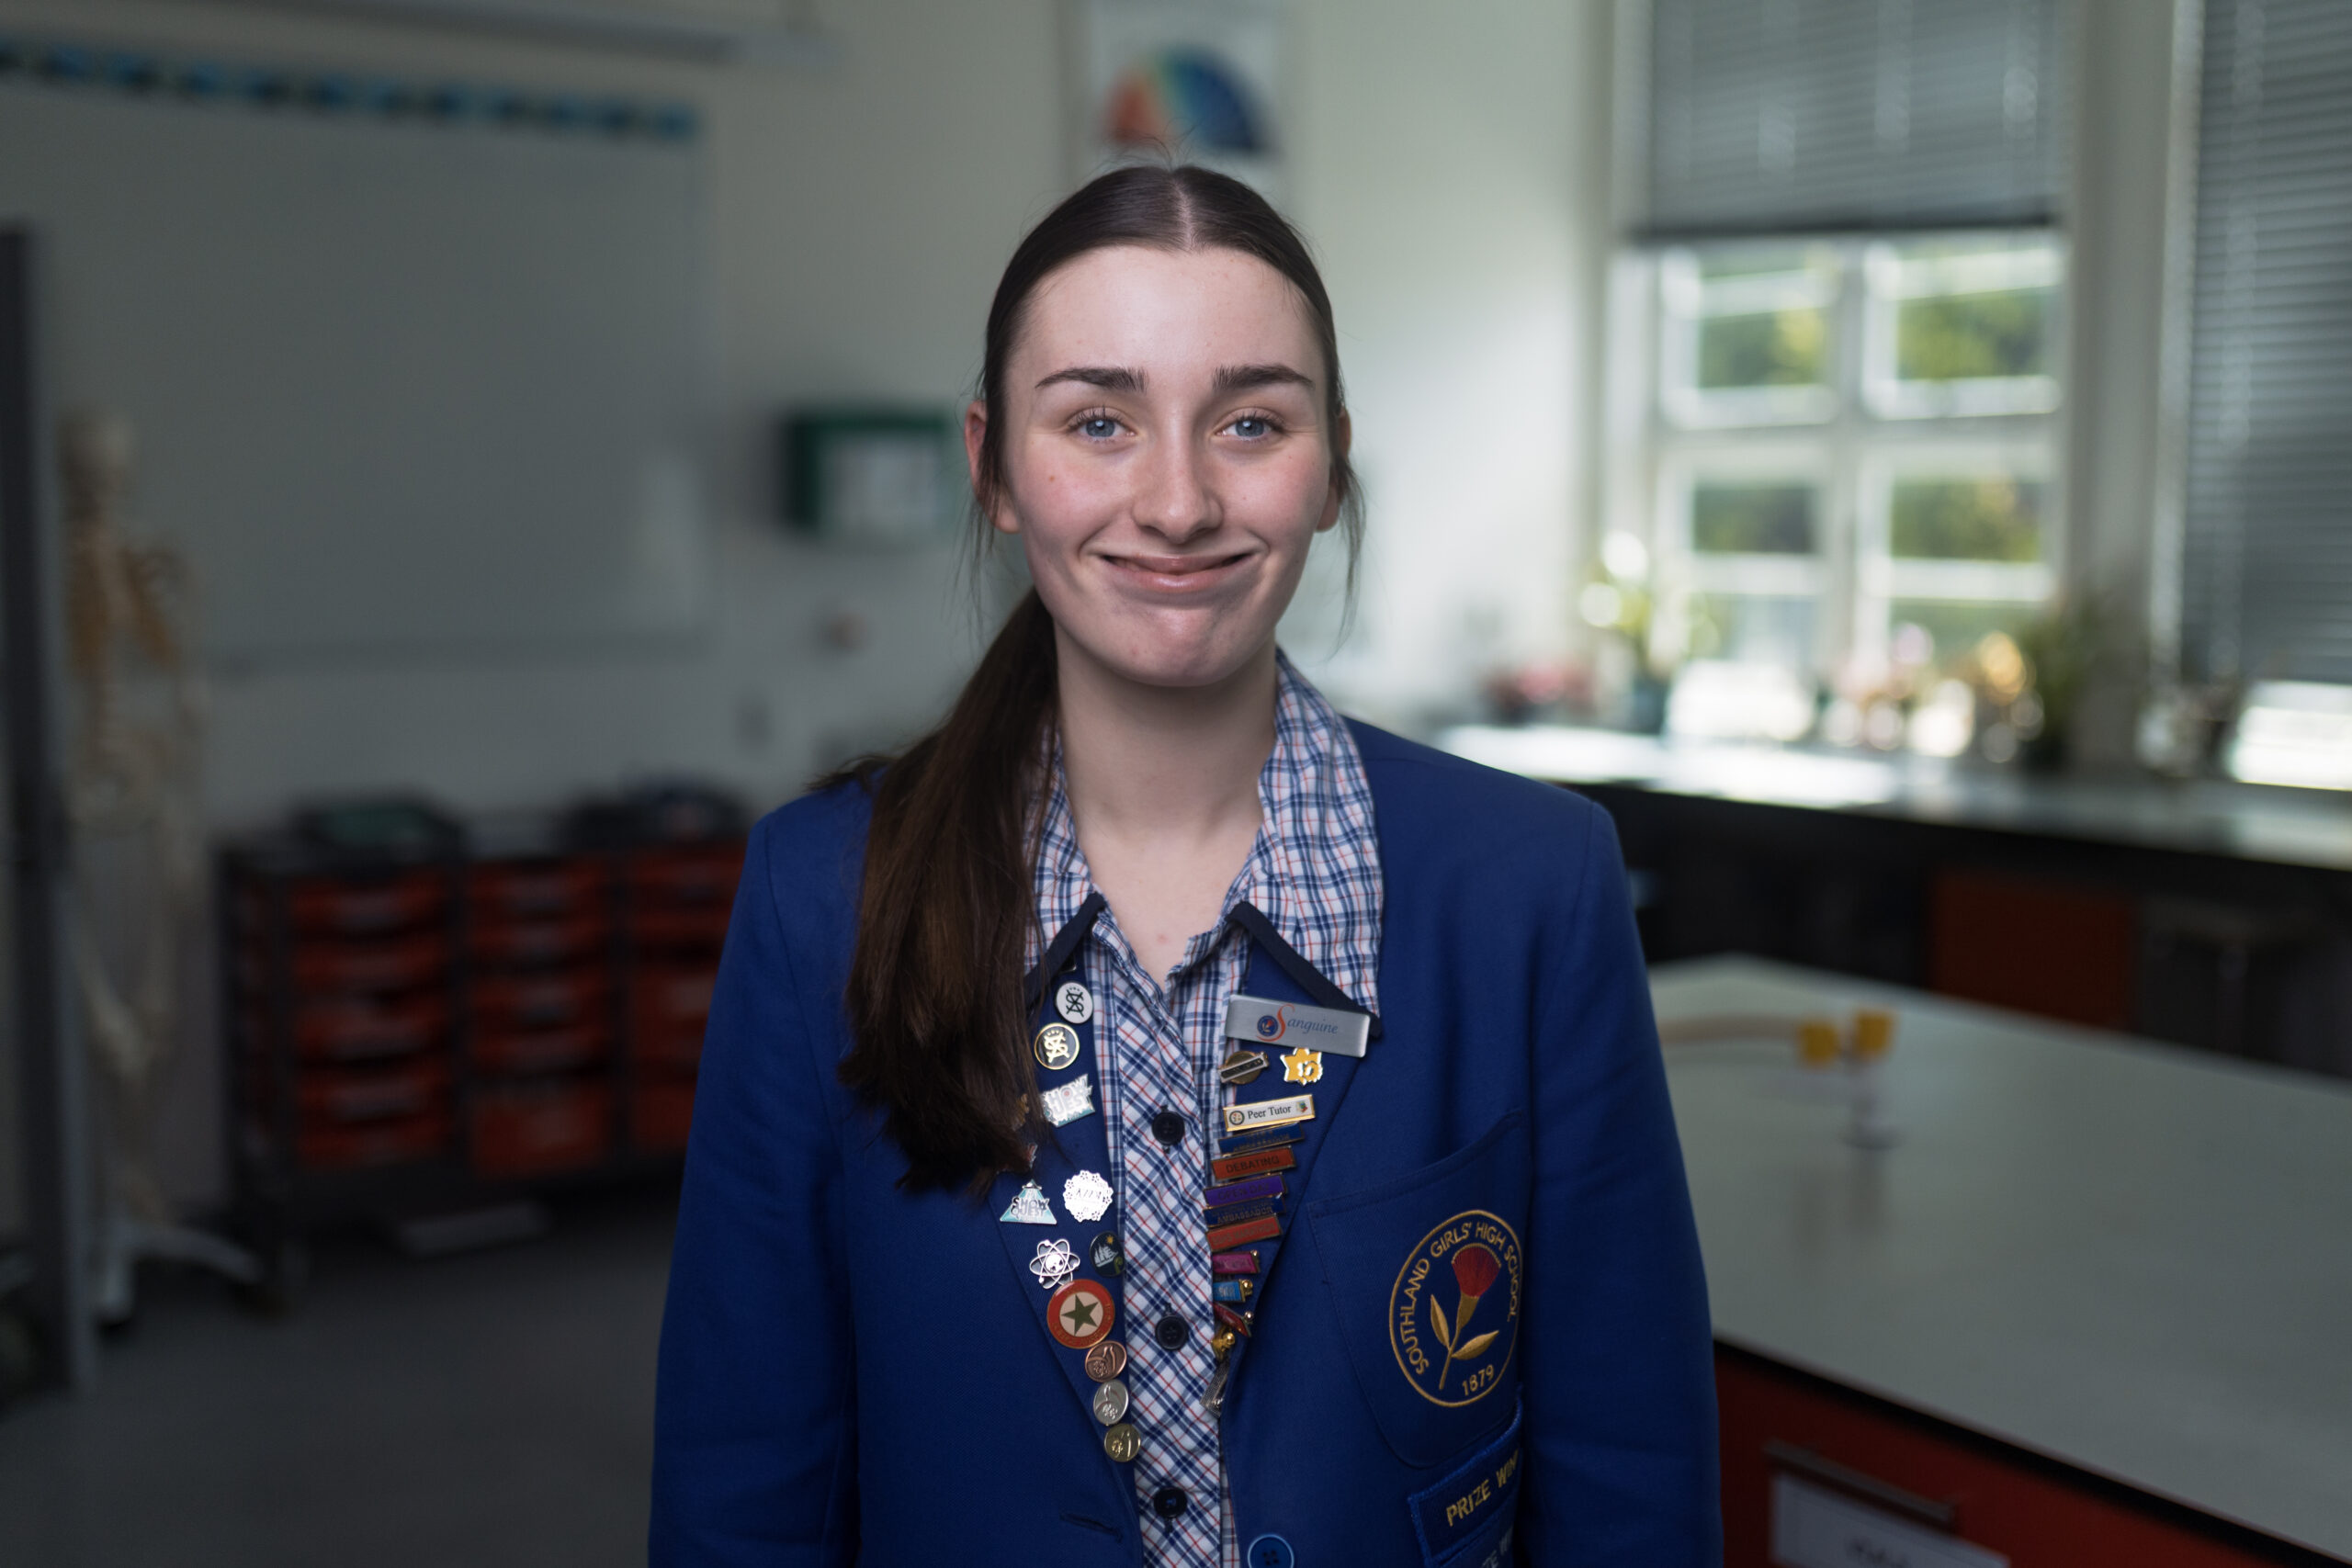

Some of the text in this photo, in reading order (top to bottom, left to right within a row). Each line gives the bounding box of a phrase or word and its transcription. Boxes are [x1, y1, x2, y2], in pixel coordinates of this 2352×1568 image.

[1256, 1003, 1339, 1043] Sanguine
[1248, 1105, 1292, 1120] Peer Tutor
[1226, 1156, 1280, 1174] DEBATING
[1012, 1196, 1050, 1211] SHOW
[1216, 1206, 1273, 1224] AMBASSADOR
[1399, 1258, 1430, 1375] SOUTHLAND
[1430, 1222, 1473, 1258] GIRLS'
[1475, 1221, 1508, 1251] HIGH
[1462, 1364, 1495, 1397] 1879
[1445, 1479, 1492, 1528] PRIZE
